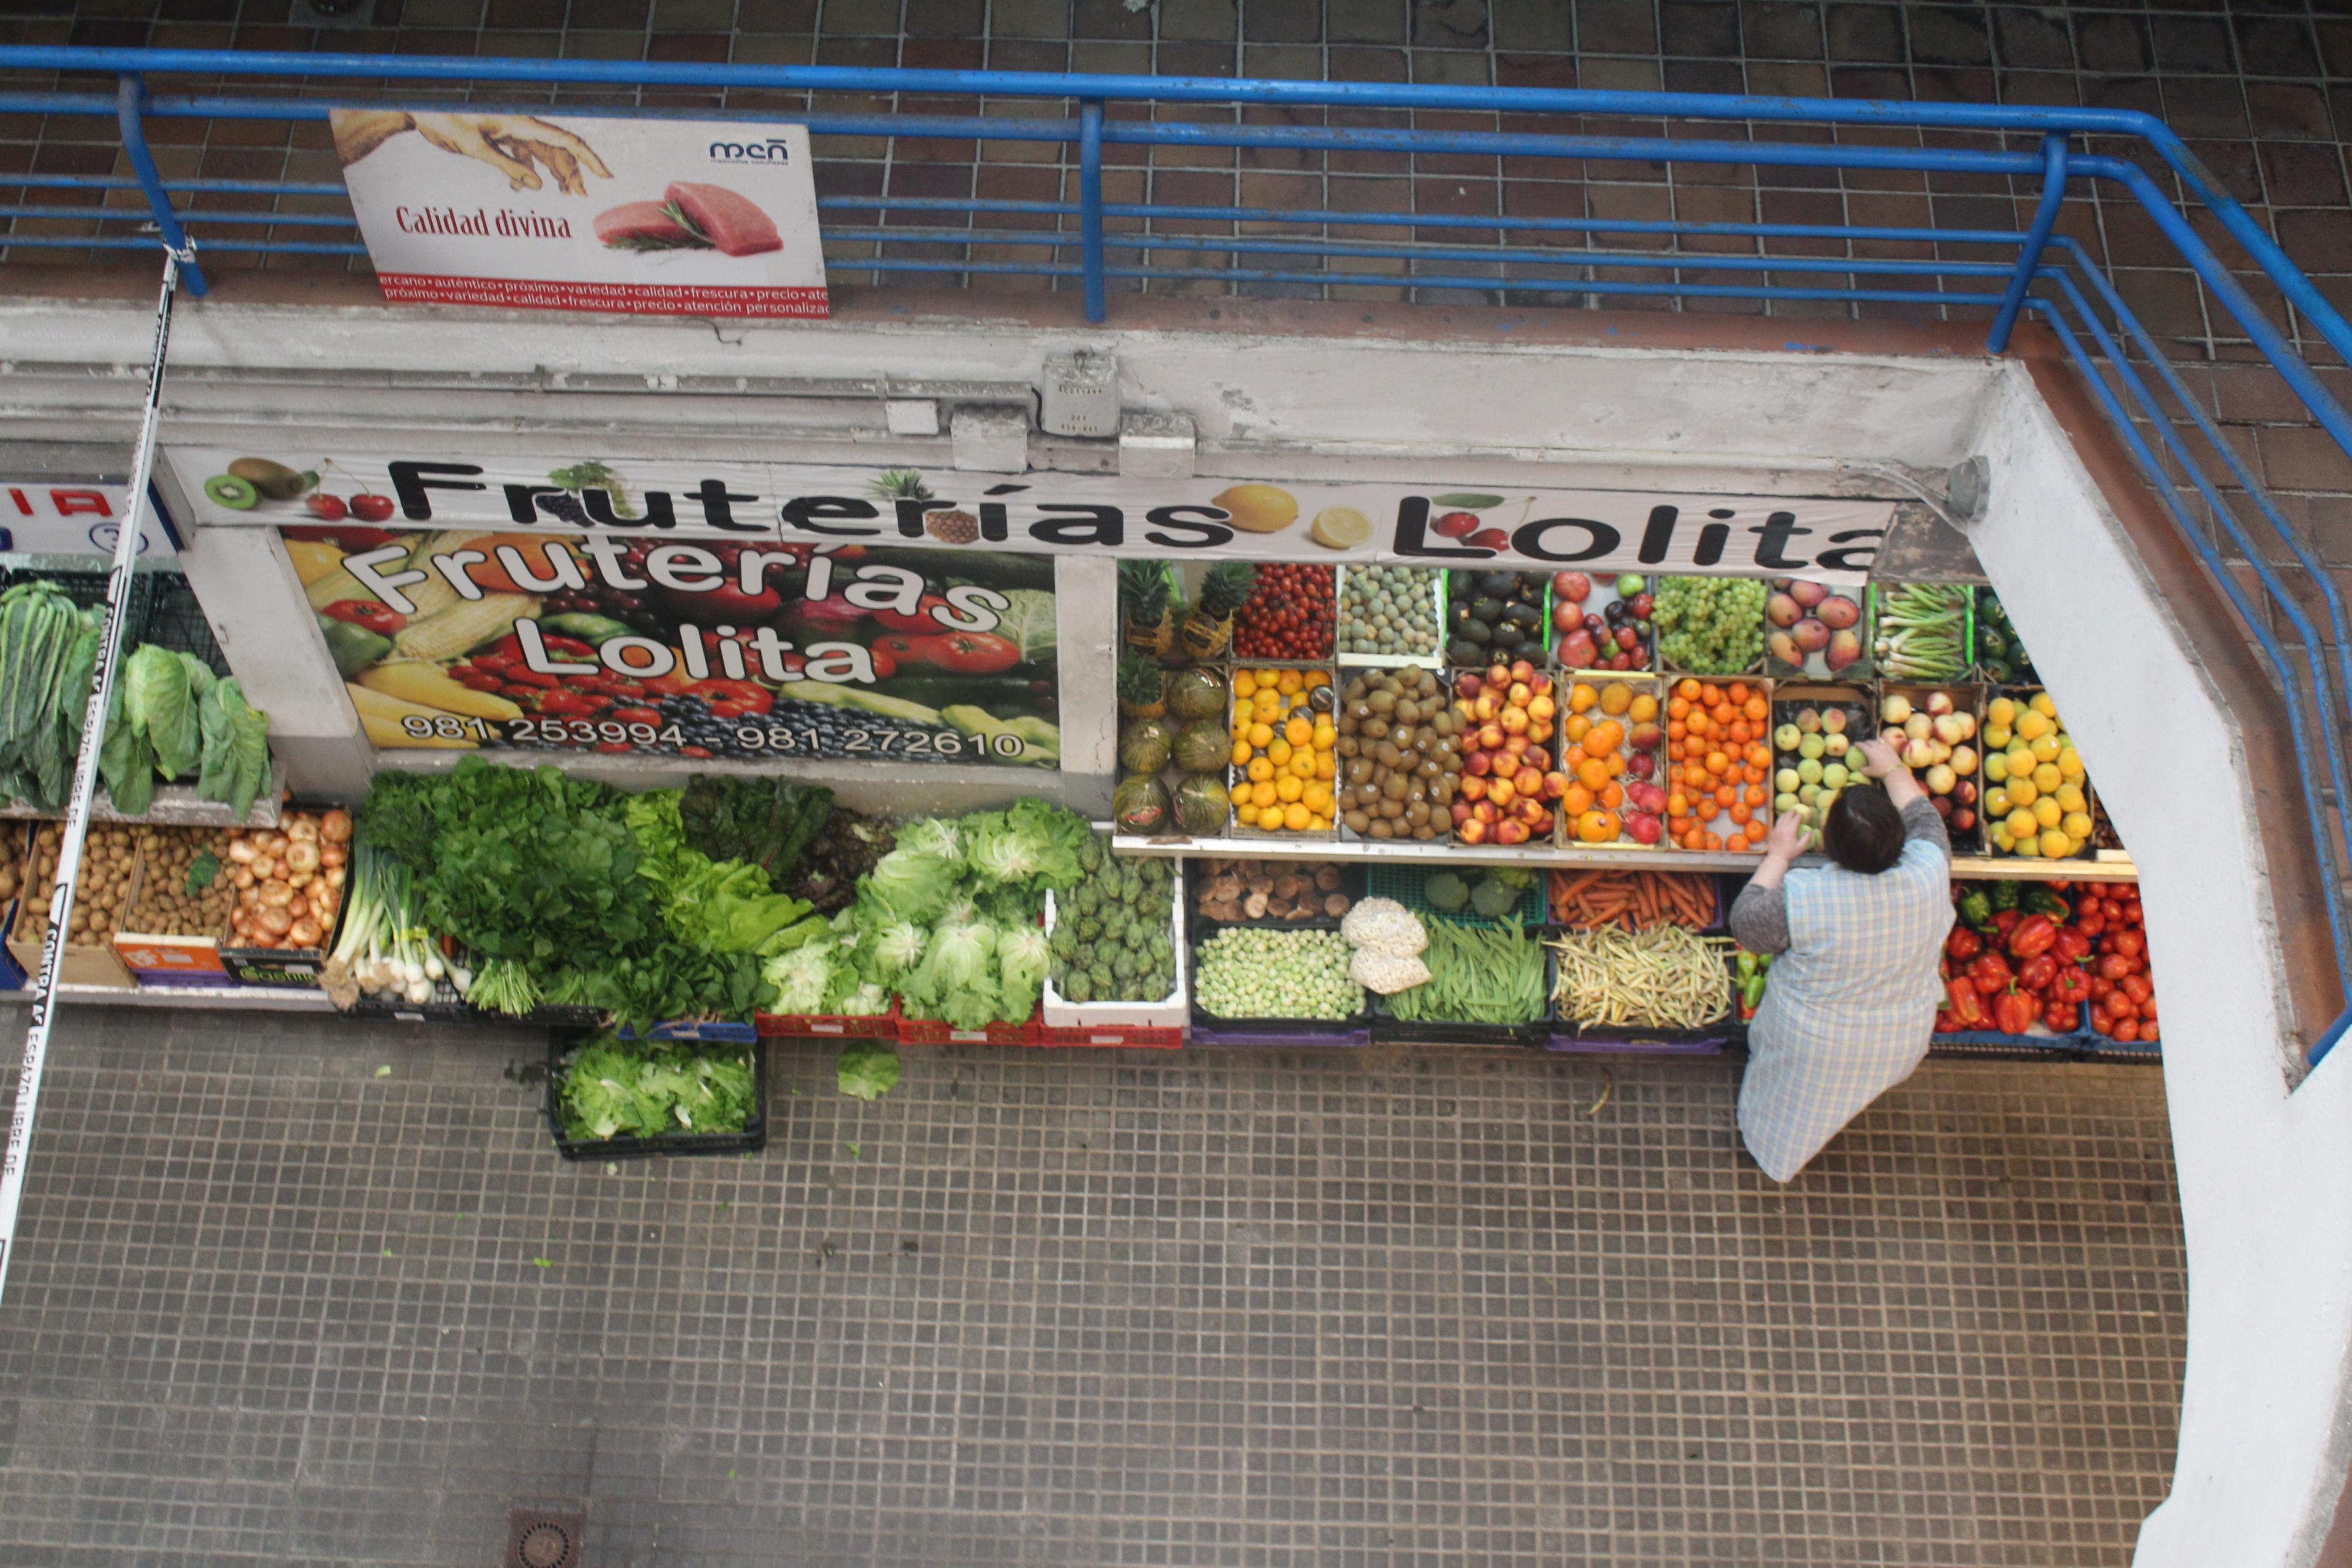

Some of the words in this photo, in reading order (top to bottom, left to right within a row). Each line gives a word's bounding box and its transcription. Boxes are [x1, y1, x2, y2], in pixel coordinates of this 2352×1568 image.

[396, 206, 490, 236] Calidad
[495, 208, 573, 239] divina
[385, 287, 439, 300] próximo
[446, 291, 505, 303] variedad
[513, 293, 561, 306] calidad
[567, 295, 626, 309] frescura
[633, 298, 676, 312] precio
[684, 300, 741, 313] atención
[435, 277, 497, 290] auténtico
[505, 280, 559, 293] próximo
[567, 283, 626, 297] variedad
[634, 285, 683, 298] calidad
[691, 286, 749, 300] frescura
[756, 287, 799, 302] precio
[389, 461, 1234, 548] Fruterías
[1393, 496, 1885, 571] Lolita
[342, 535, 1012, 634] Fruterías
[512, 617, 877, 684] Lolita
[402, 716, 488, 740] 981
[508, 719, 687, 747] 253994
[736, 726, 820, 750] 981
[843, 729, 1013, 757] 272610
